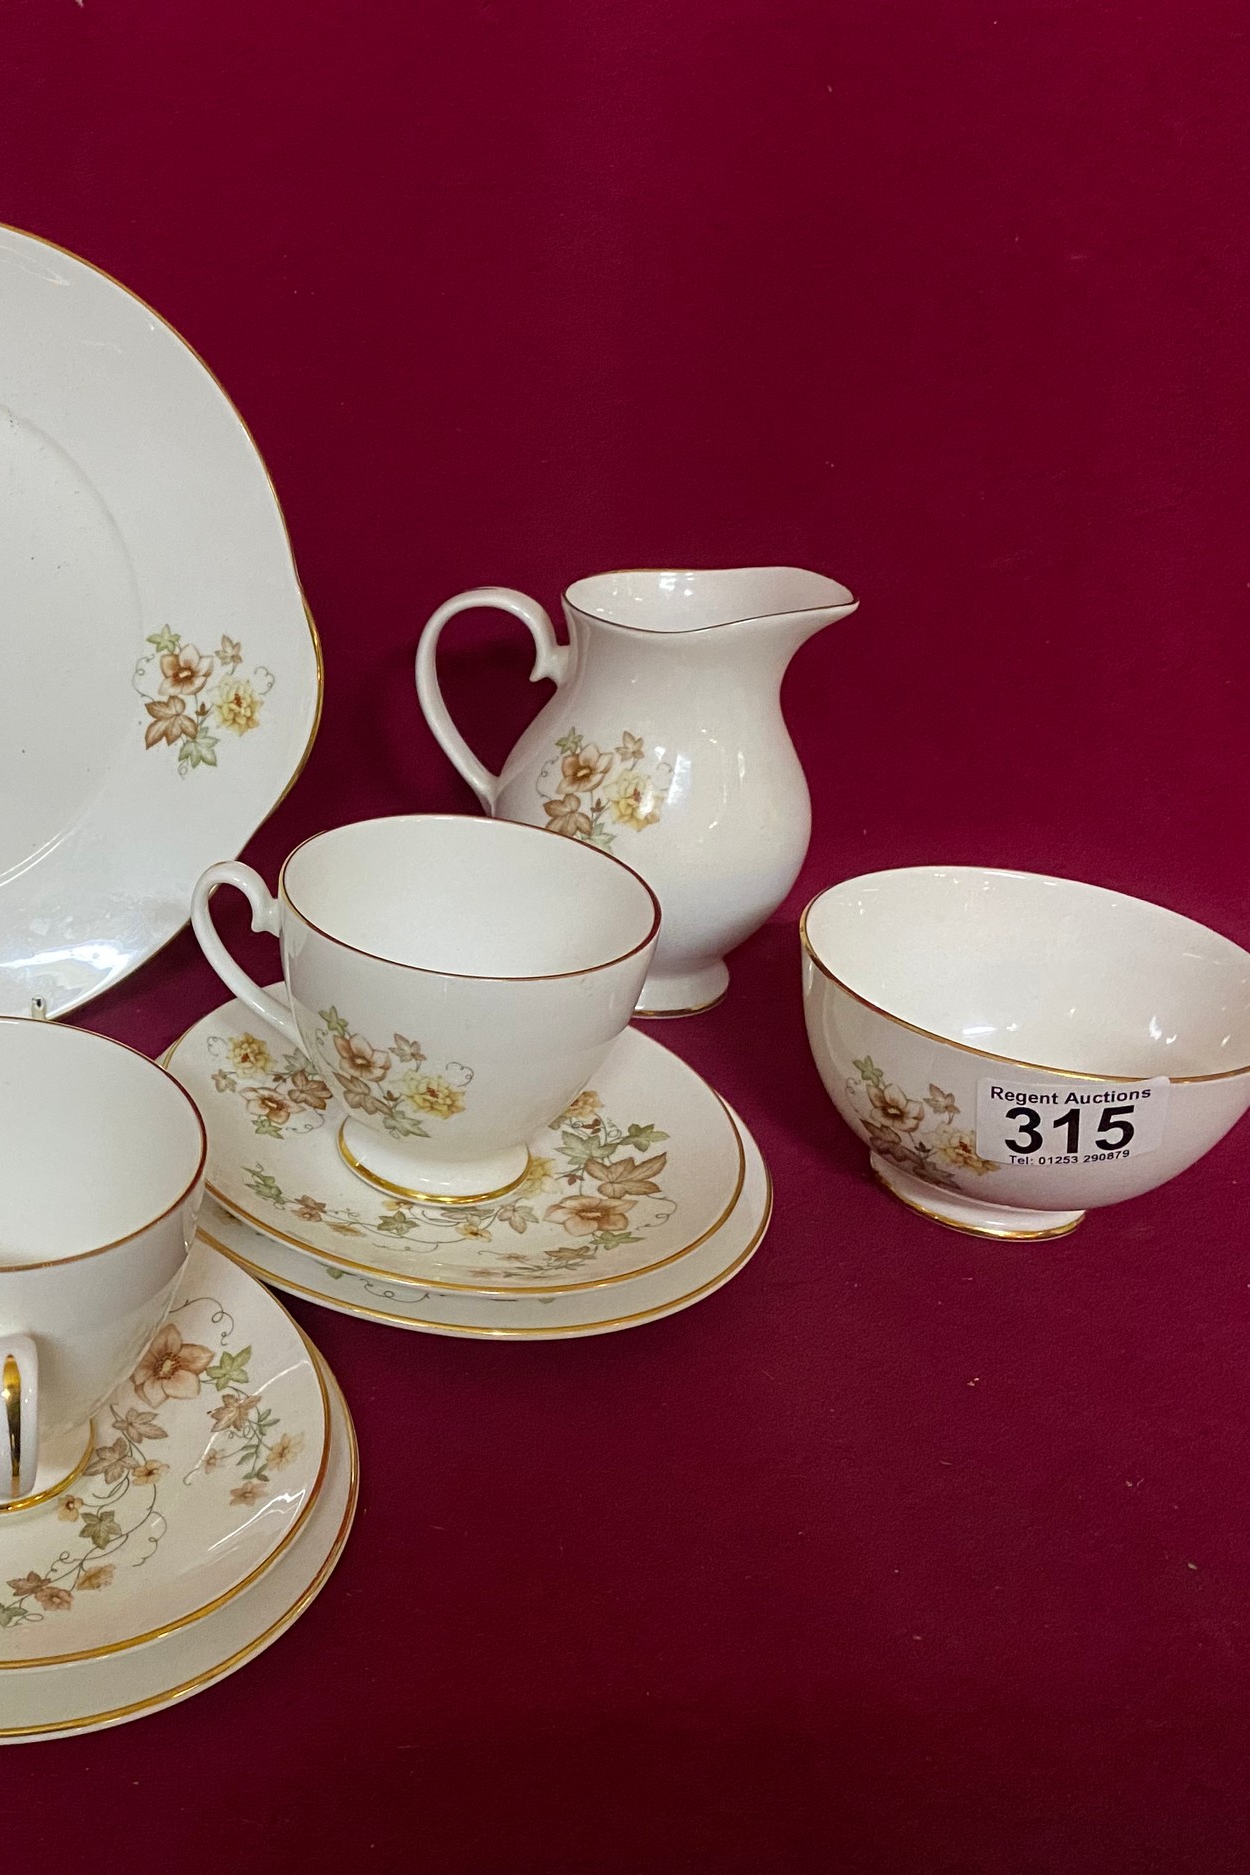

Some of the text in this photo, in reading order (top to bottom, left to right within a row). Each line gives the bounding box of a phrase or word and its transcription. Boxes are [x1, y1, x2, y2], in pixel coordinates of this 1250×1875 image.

[991, 1086, 1151, 1105] Regent Auctions
[1004, 1105, 1135, 1154] 315
[1009, 1150, 1130, 1165] Tel: 01253 290879
